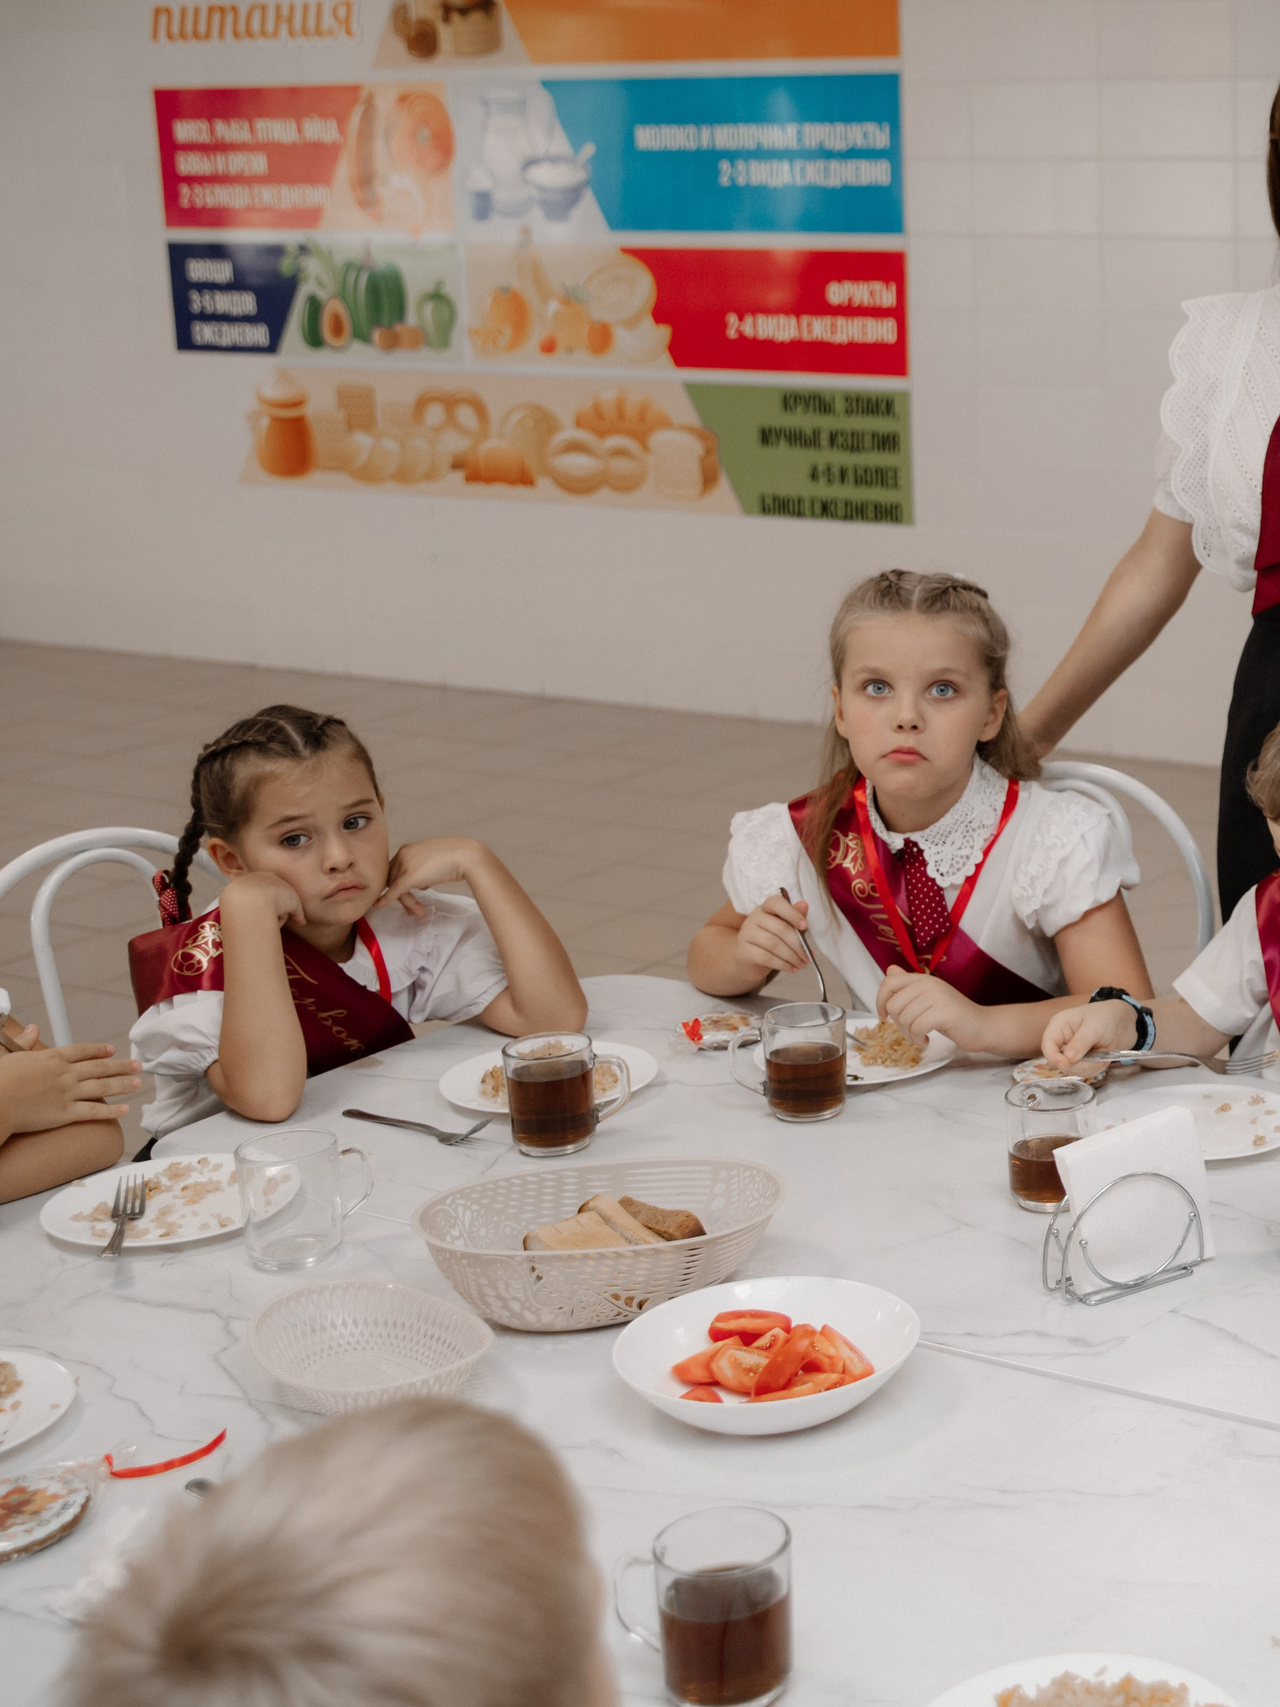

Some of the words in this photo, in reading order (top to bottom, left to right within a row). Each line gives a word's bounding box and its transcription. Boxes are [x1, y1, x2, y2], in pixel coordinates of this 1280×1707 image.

[151, 1, 356, 43] питания
[634, 123, 699, 151] МОЛОКО
[700, 123, 713, 150] И
[801, 121, 891, 152] ПРОДУКТЫ
[718, 158, 747, 187] 2-3
[748, 158, 792, 188] ВИДА
[793, 158, 892, 189] ЕЖЕДНЕВНО
[825, 279, 897, 308] ФРУКТЫ
[725, 311, 755, 340] 2-4
[755, 312, 800, 343] ВИДА
[800, 313, 898, 345] ЕЖЕДНЕВНО
[760, 425, 823, 449] МУЧНЫЕ
[828, 428, 900, 454] ИЗДЕЛИЯ
[838, 465, 850, 486] И
[853, 465, 899, 490] БОЛЕЕ
[760, 492, 807, 518] БЛЮД
[809, 496, 904, 524] ЕЖЕДНЕВНО
